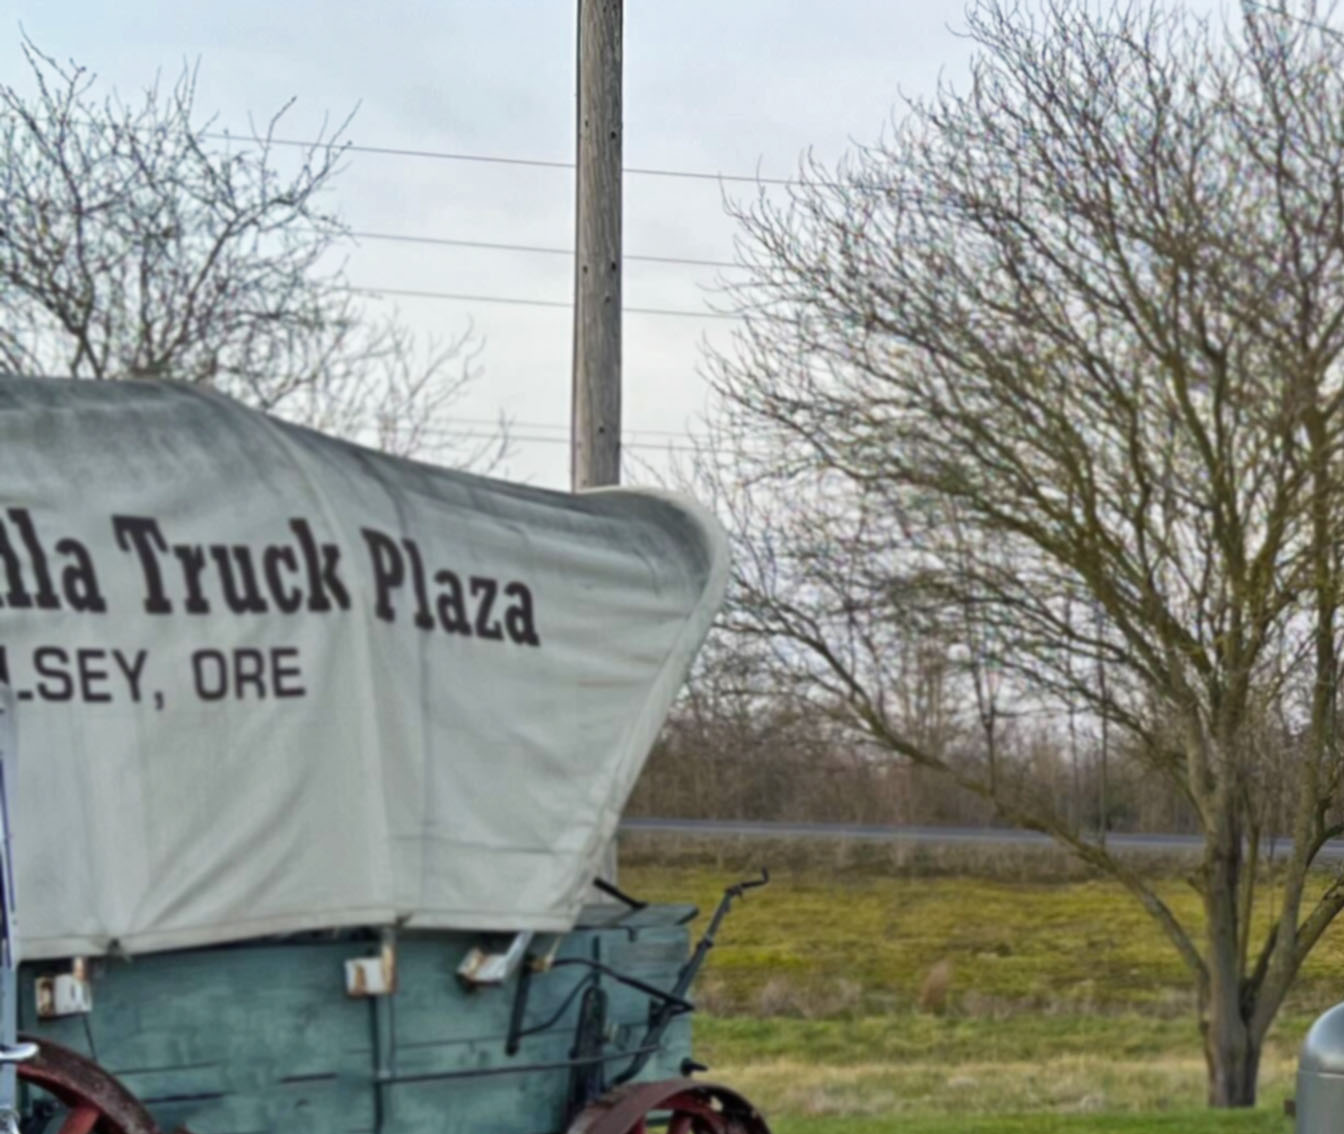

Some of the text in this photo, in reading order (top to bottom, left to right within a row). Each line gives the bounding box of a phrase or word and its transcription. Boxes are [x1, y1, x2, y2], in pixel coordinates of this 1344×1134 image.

[0, 507, 541, 648] lla Truck Plaza
[0, 644, 307, 710] SEY, ORE
